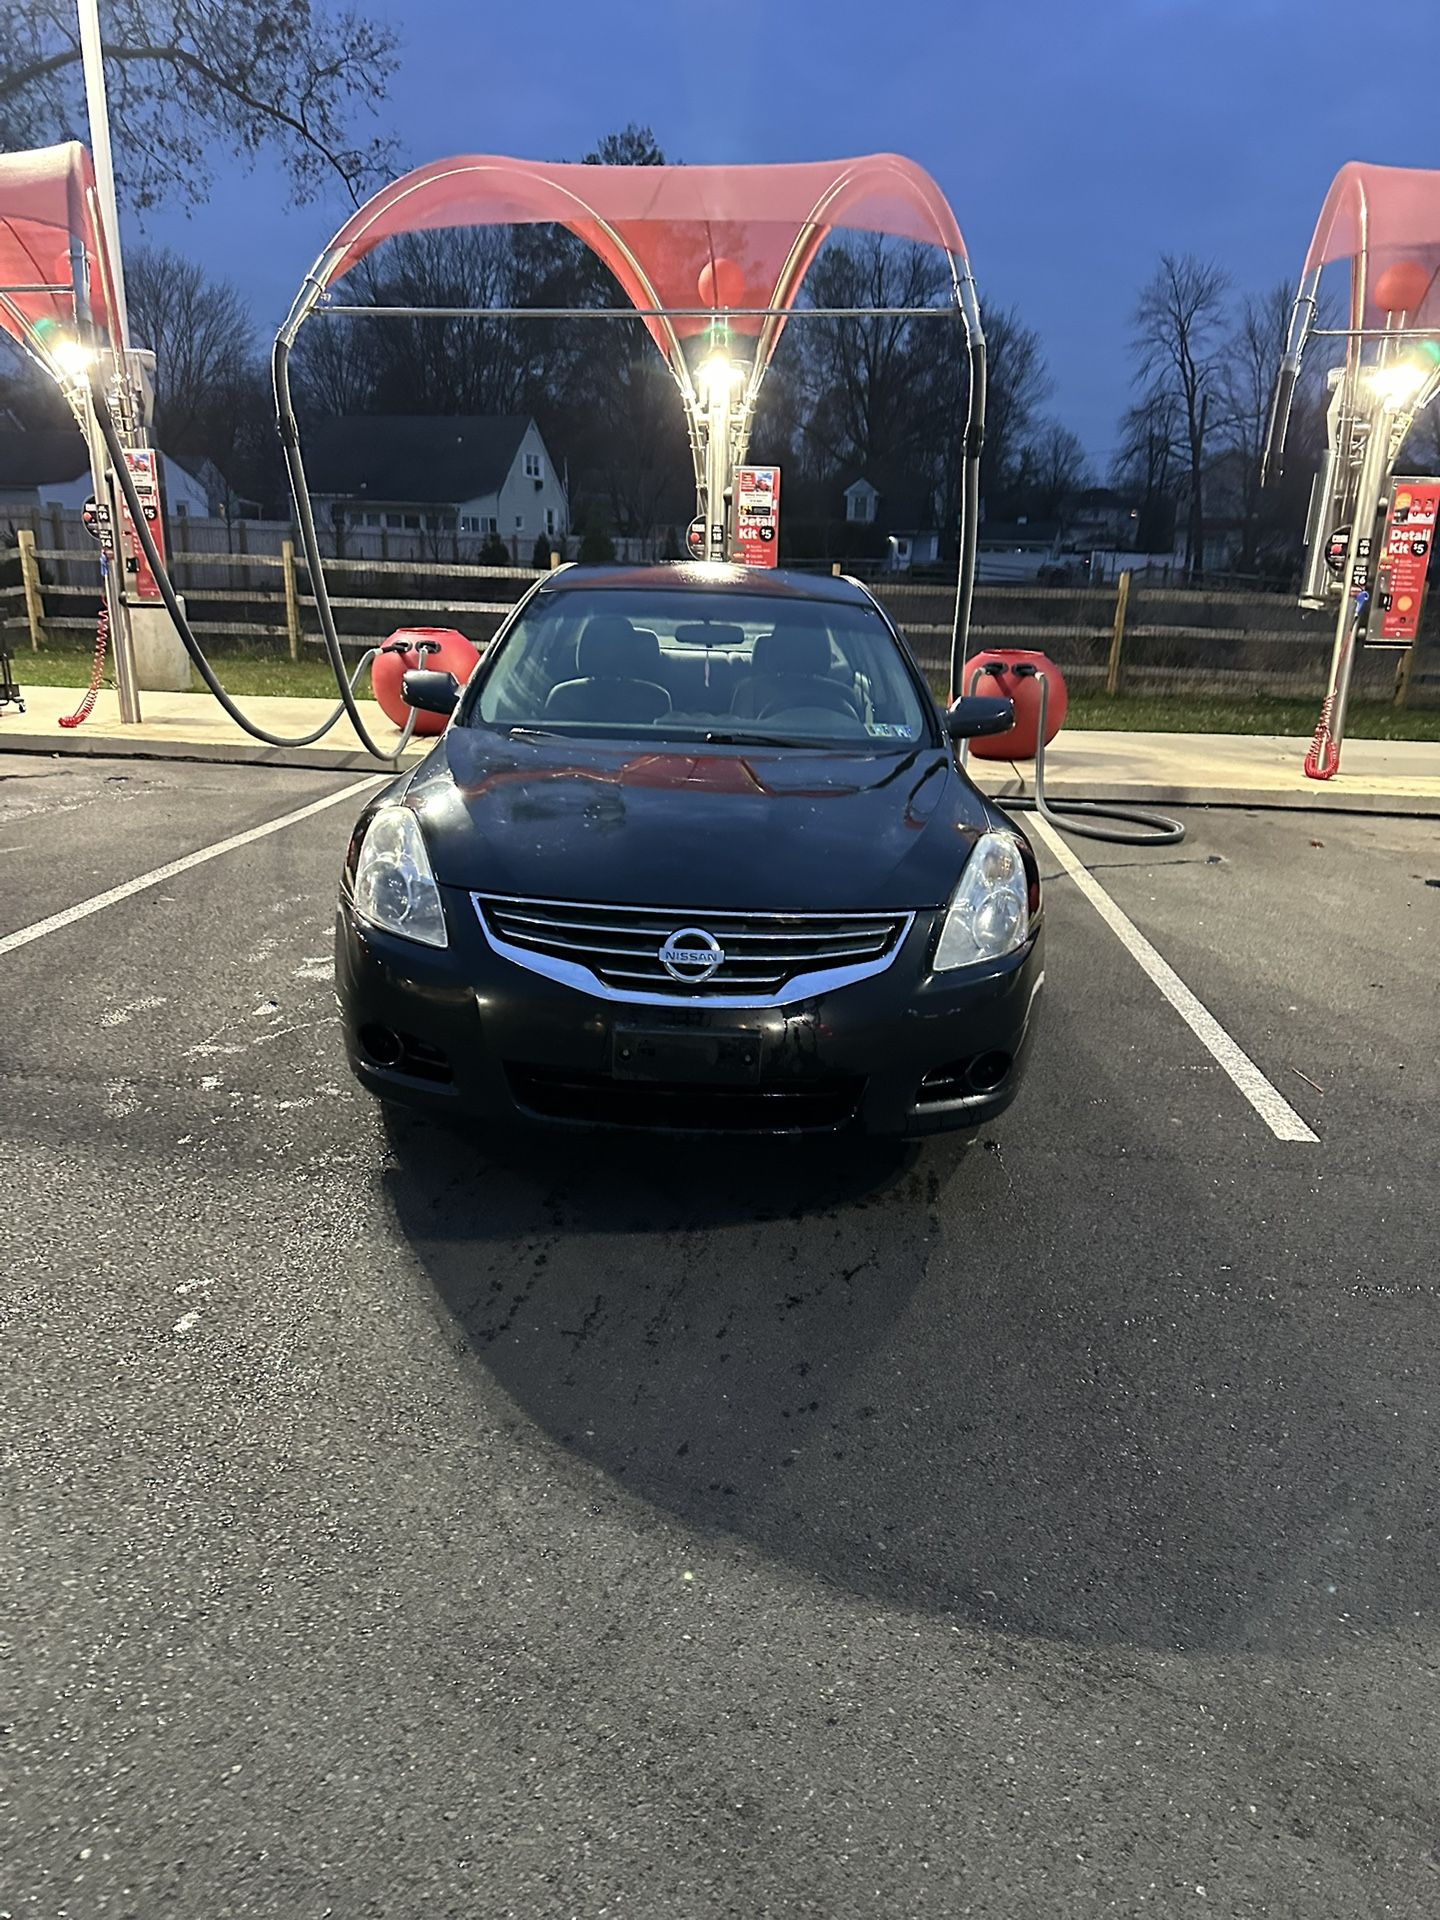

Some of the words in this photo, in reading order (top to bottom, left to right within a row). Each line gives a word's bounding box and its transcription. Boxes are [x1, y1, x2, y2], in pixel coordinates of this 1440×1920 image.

[98, 512, 108, 520] 14
[739, 517, 775, 527] Detail
[712, 533, 722, 541] 15
[739, 528, 758, 539] Kit
[761, 529, 772, 540] $5
[1391, 529, 1431, 541] Detail
[101, 539, 112, 547] 14
[1359, 547, 1369, 555] 16
[1389, 542, 1410, 555] Kit
[1413, 543, 1424, 554] $5
[1353, 575, 1366, 584] 16
[665, 951, 717, 961] NISSAN
